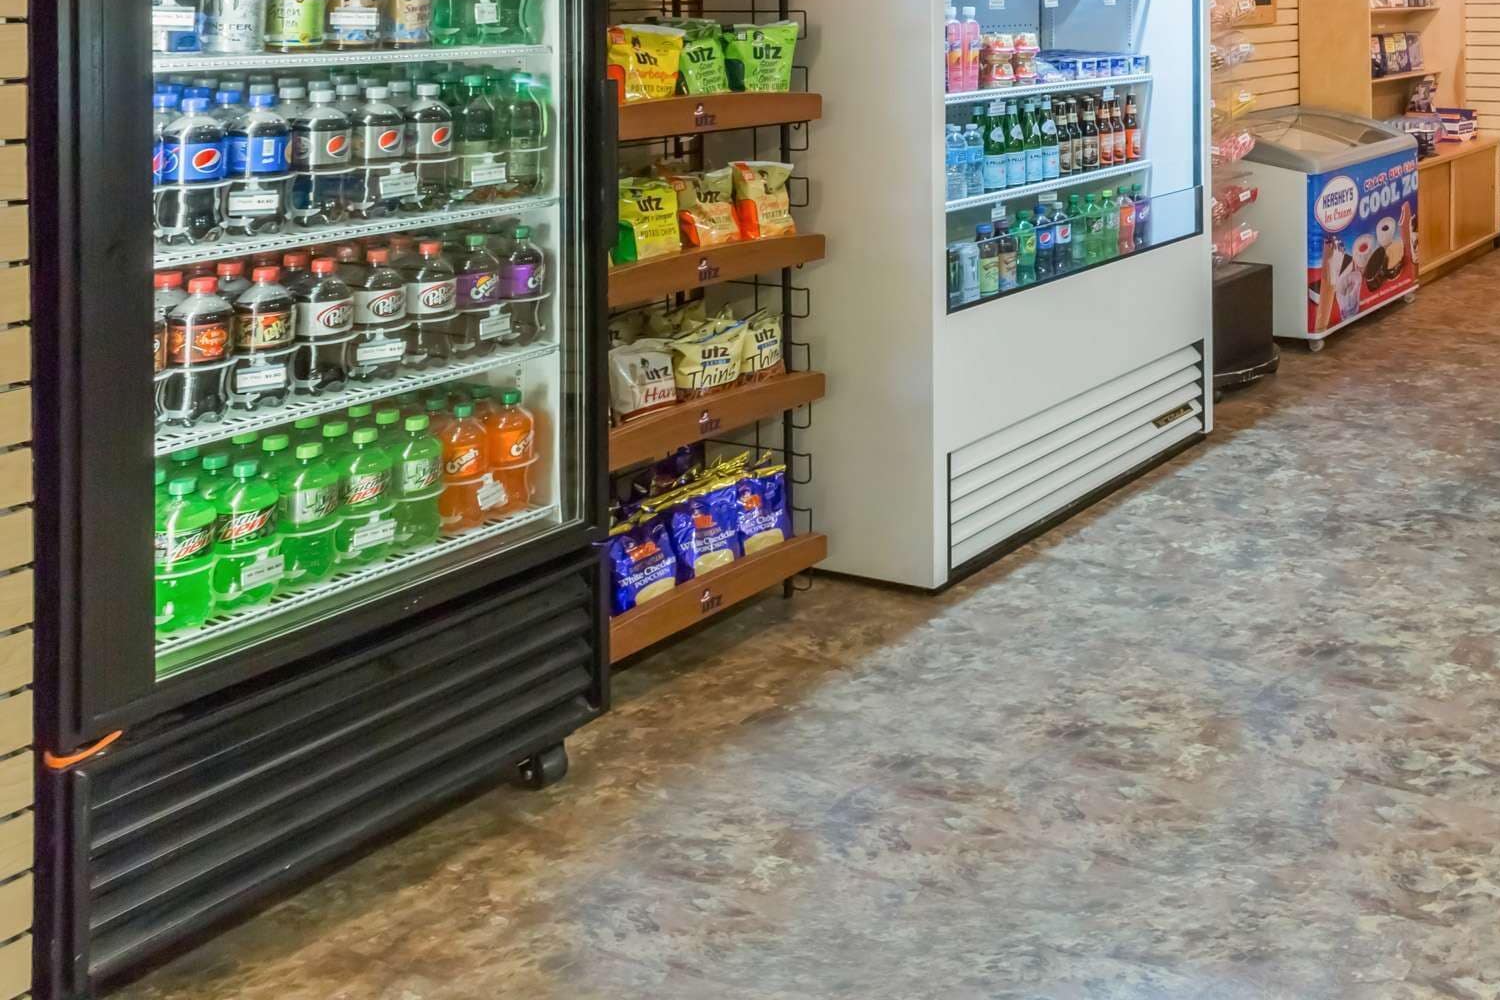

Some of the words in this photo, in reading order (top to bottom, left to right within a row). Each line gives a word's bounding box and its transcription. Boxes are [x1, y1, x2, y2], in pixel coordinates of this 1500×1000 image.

[687, 47, 716, 63] utz
[752, 44, 783, 60] utz
[637, 195, 664, 212] utz
[1322, 187, 1354, 209] HERSHEY'S
[1359, 181, 1400, 218] COOL
[754, 327, 776, 343] utz
[701, 346, 730, 360] utz
[747, 350, 781, 374] Thin
[645, 366, 671, 382] utz
[446, 448, 480, 475] Crush
[618, 571, 644, 588] White
